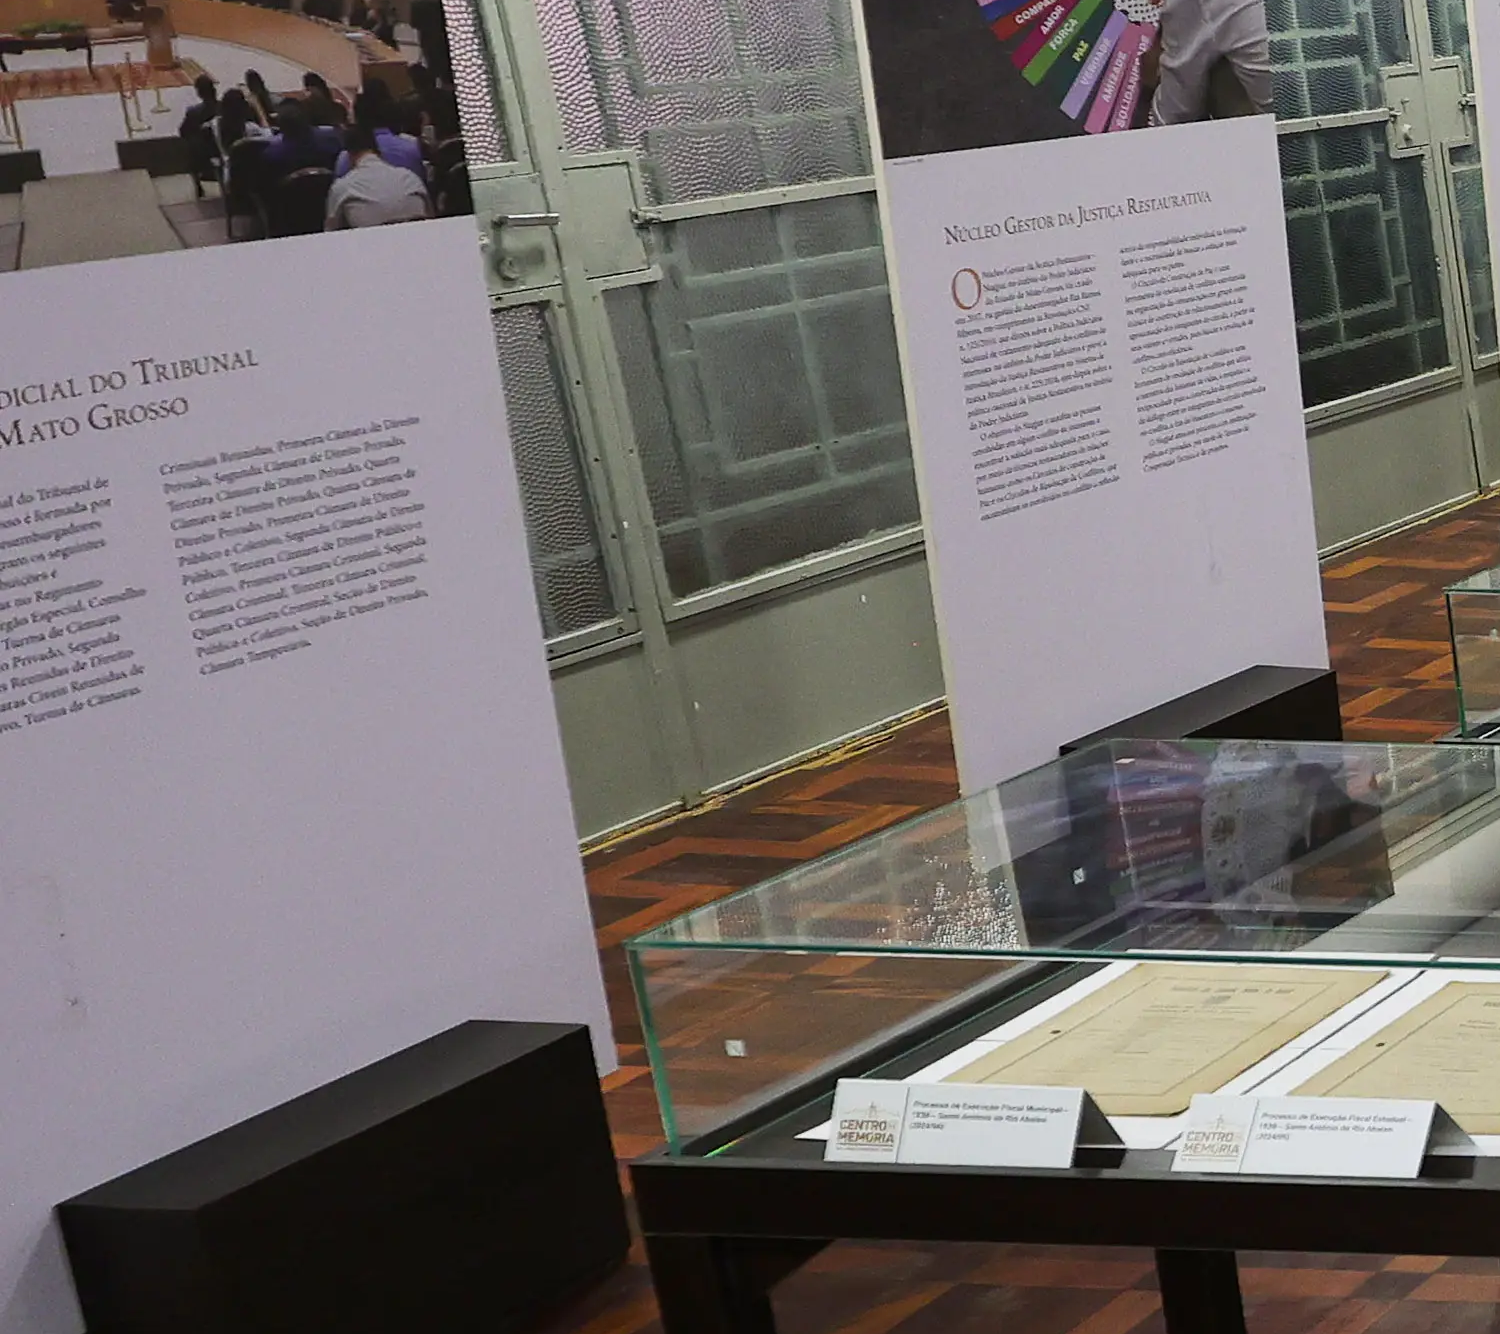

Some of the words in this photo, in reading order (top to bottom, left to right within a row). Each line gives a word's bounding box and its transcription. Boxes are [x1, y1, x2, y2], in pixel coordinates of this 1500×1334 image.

[1039, 4, 1065, 35] AMOR
[1049, 19, 1079, 51] FORÇA
[1072, 40, 1089, 62] PAZ
[1101, 51, 1128, 102] AMIZADE
[944, 224, 1000, 245] NÚCLEO
[1004, 216, 1054, 235] GESTOR
[1058, 213, 1074, 227] DA
[1076, 205, 1124, 228] JUSTIÇA
[1126, 190, 1212, 215] RESTAURATIVA
[88, 371, 127, 394] DO
[132, 349, 258, 385] TRIBUNAL
[0, 417, 80, 450] MATO
[88, 397, 188, 431] GROSSO
[839, 1119, 887, 1132] CENTRO
[1185, 1131, 1234, 1143] CENTRO
